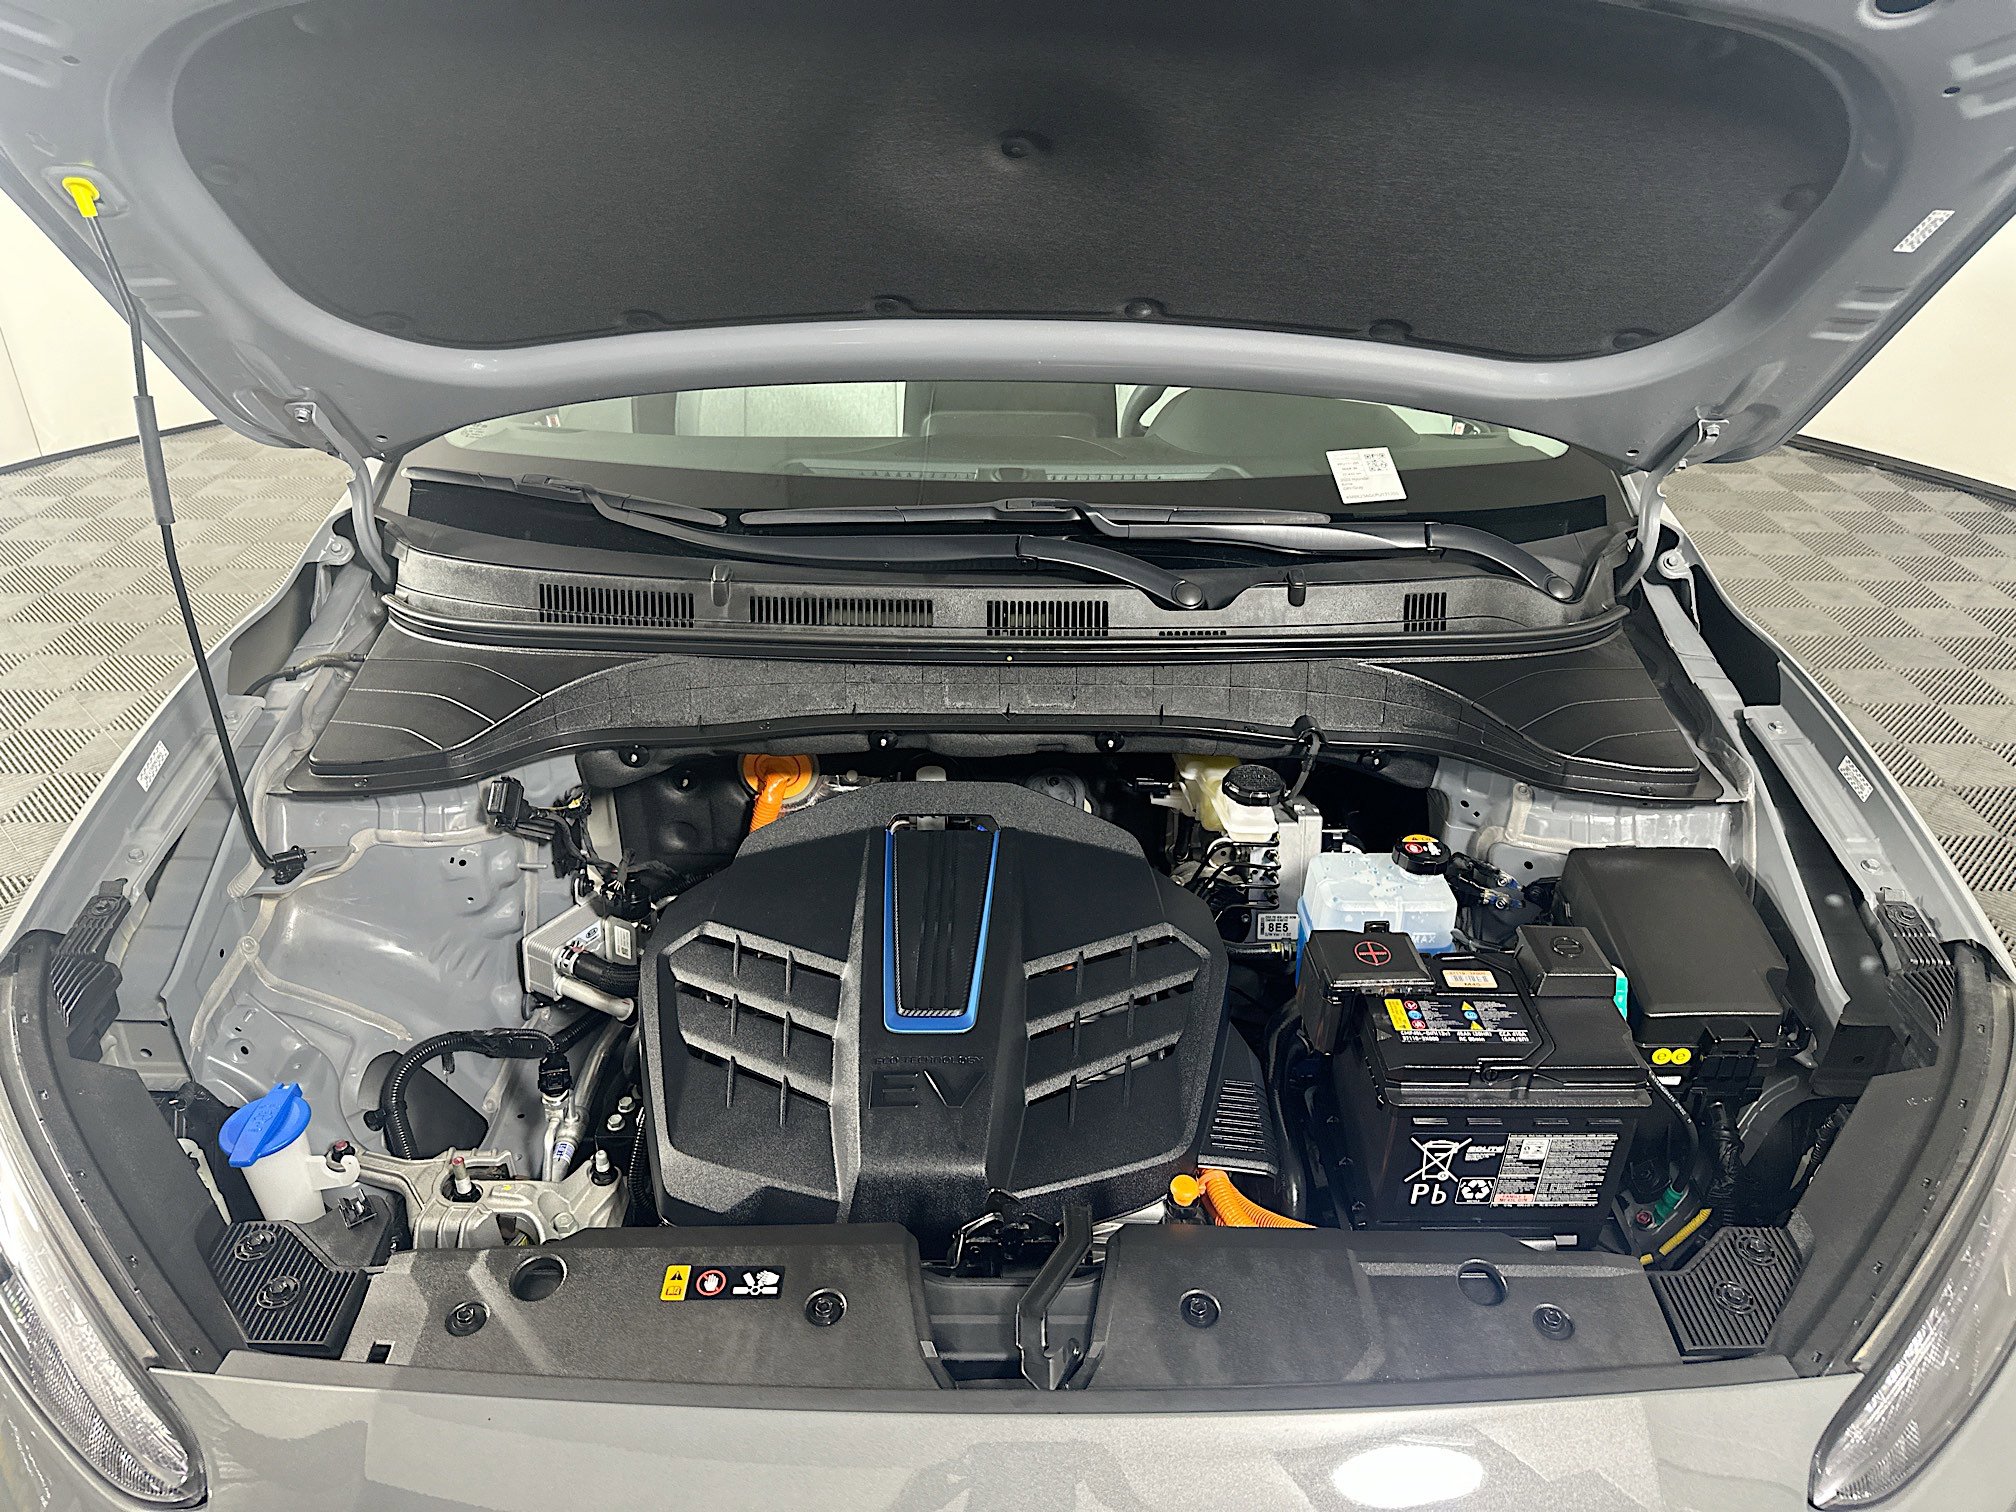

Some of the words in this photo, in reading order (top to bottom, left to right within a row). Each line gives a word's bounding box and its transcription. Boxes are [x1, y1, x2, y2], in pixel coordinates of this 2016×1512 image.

[1268, 922, 1289, 933] 8E5
[868, 1070, 987, 1109] EV
[1410, 1183, 1447, 1205] Pb
